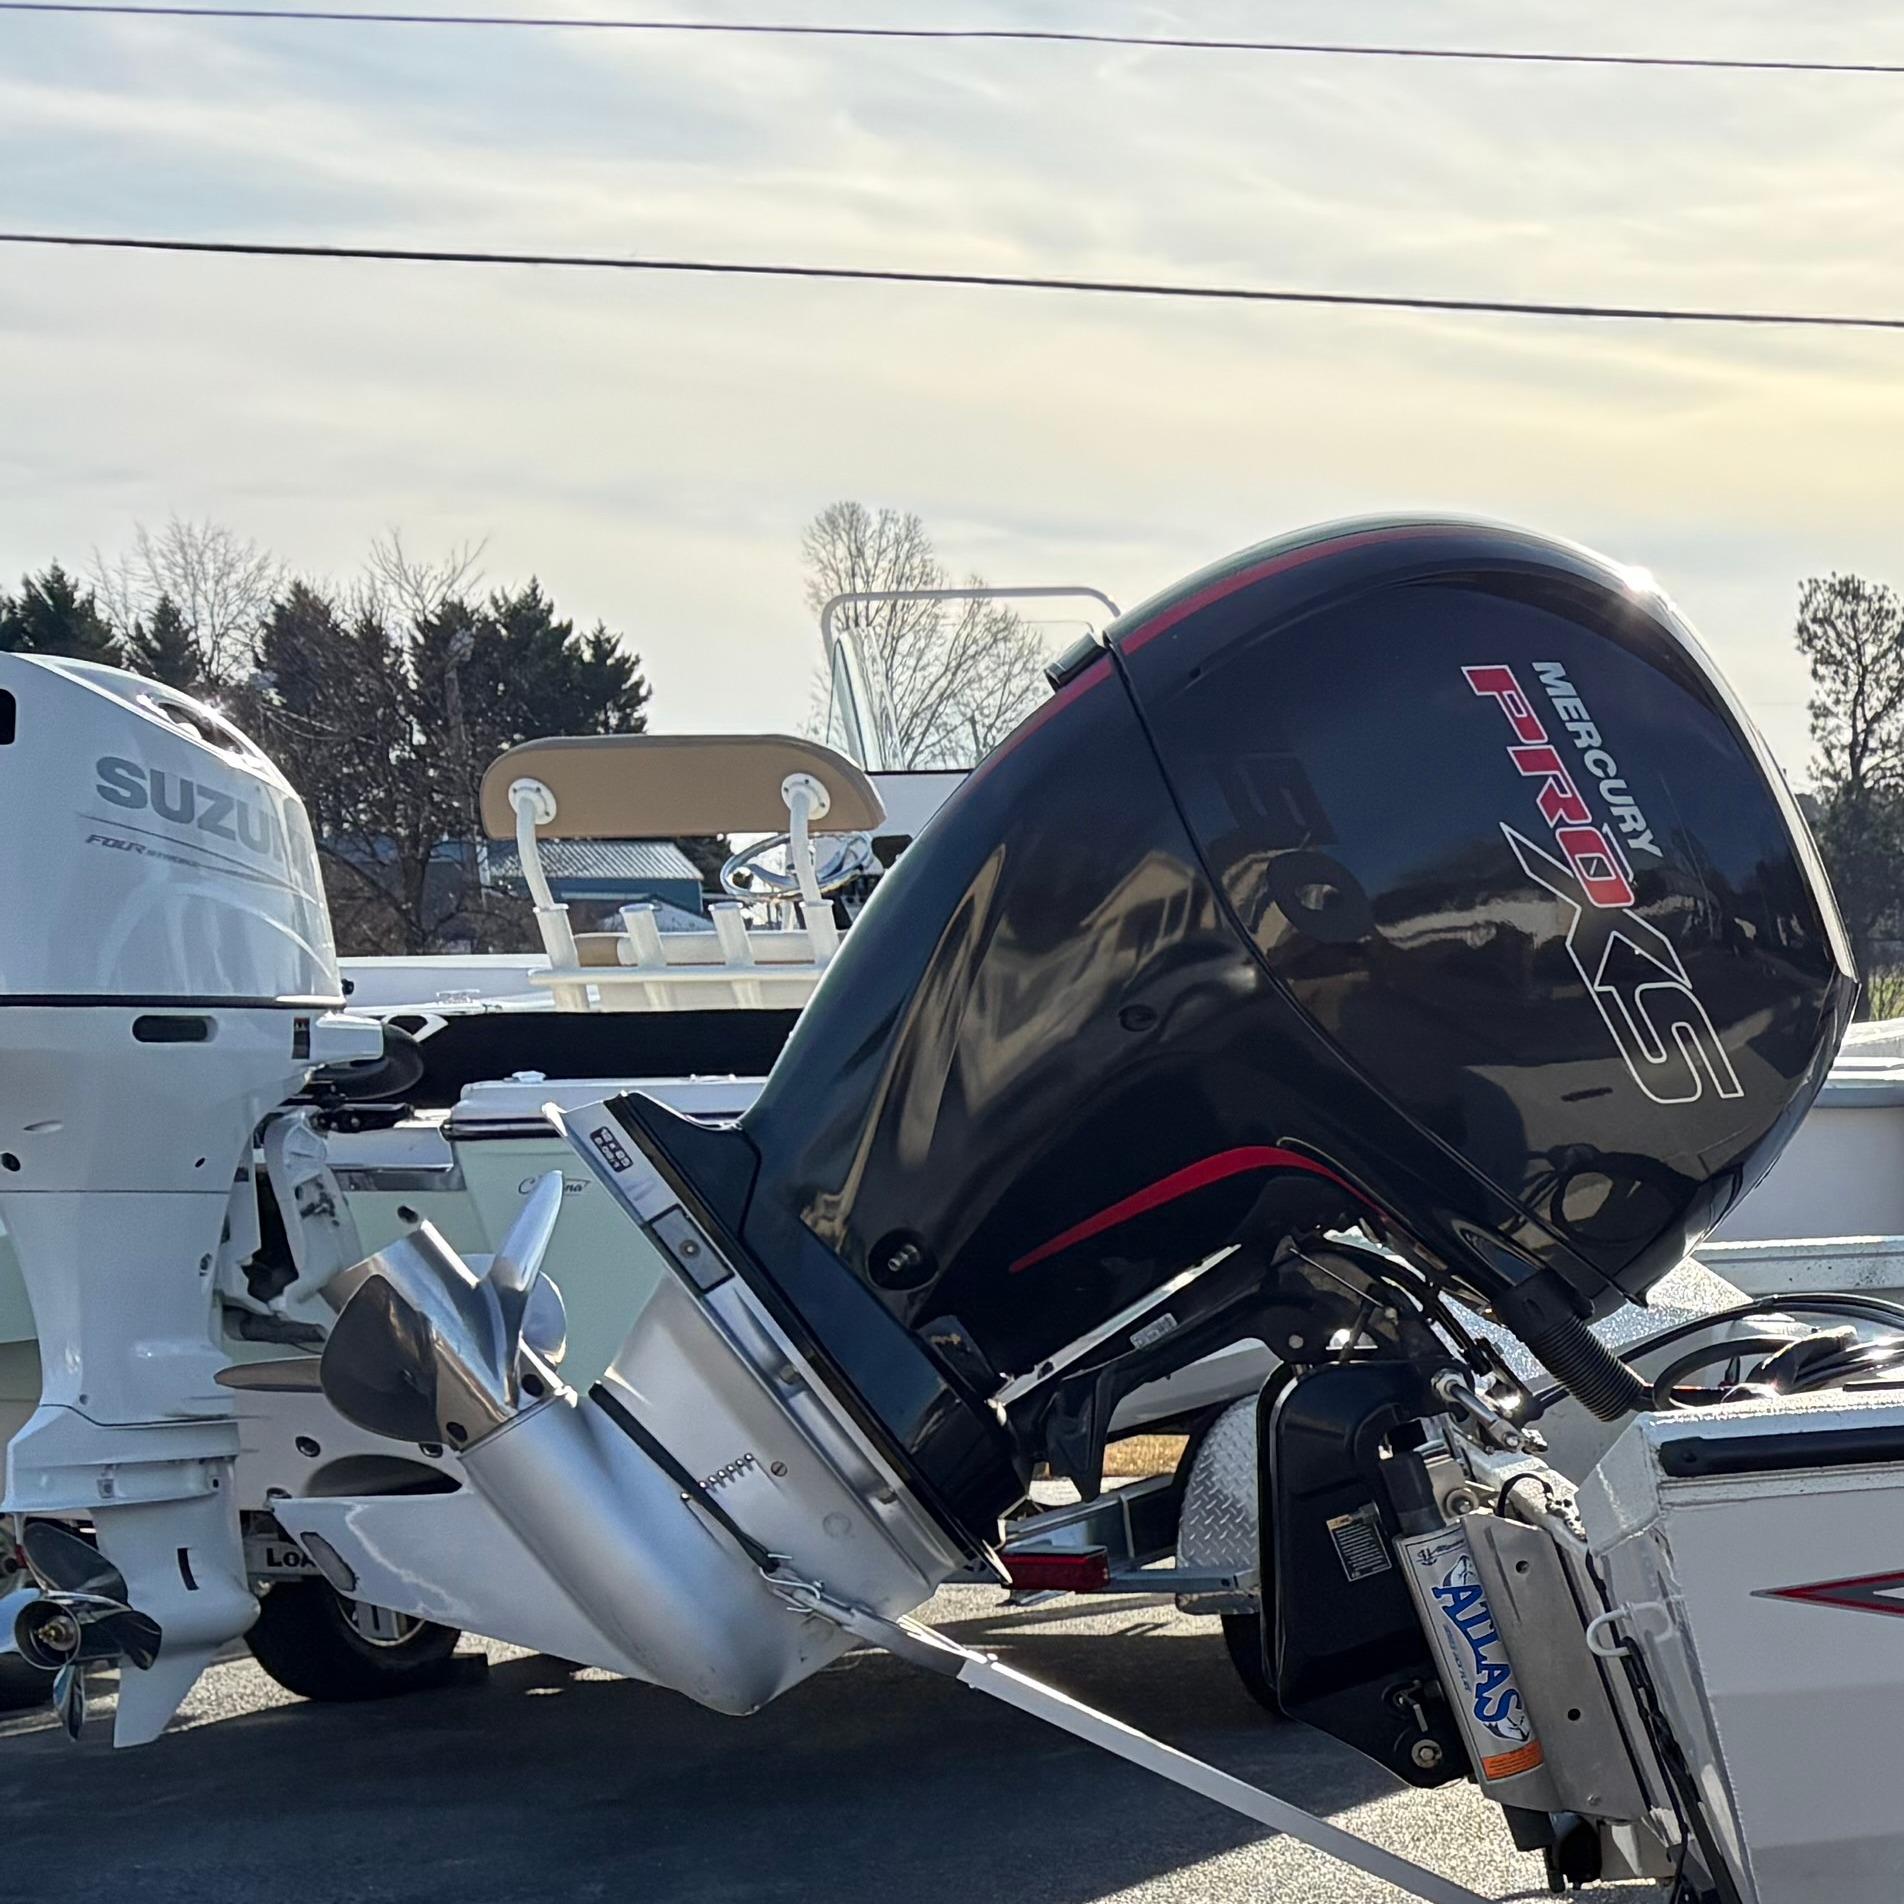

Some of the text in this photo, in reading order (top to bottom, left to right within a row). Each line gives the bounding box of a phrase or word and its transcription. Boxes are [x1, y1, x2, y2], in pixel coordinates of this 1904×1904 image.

[96, 756, 285, 863] SUZU
[1460, 664, 1635, 908] PRO
[1531, 661, 1663, 858] MERCURY
[85, 833, 146, 855] FOUR
[1499, 821, 1744, 1104] XS
[1431, 1584, 1522, 1724] ATLAS
